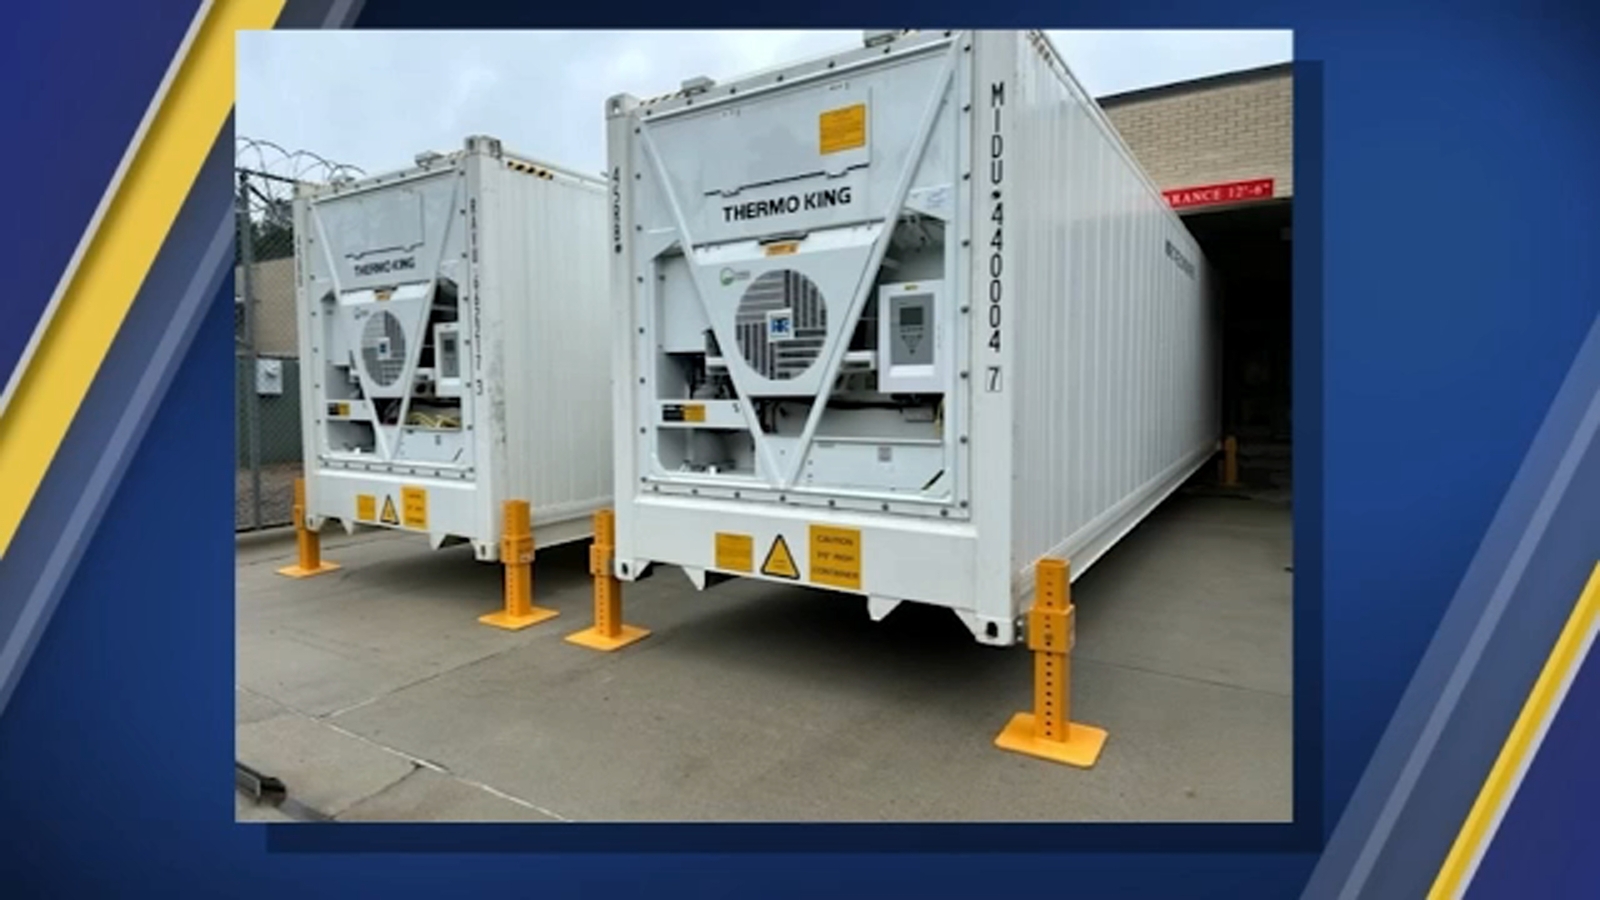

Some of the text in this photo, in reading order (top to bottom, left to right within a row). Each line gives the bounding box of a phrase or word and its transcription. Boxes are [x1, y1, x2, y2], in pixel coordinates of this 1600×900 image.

[722, 186, 852, 222] THERMO KING
[987, 366, 1000, 390] 7
